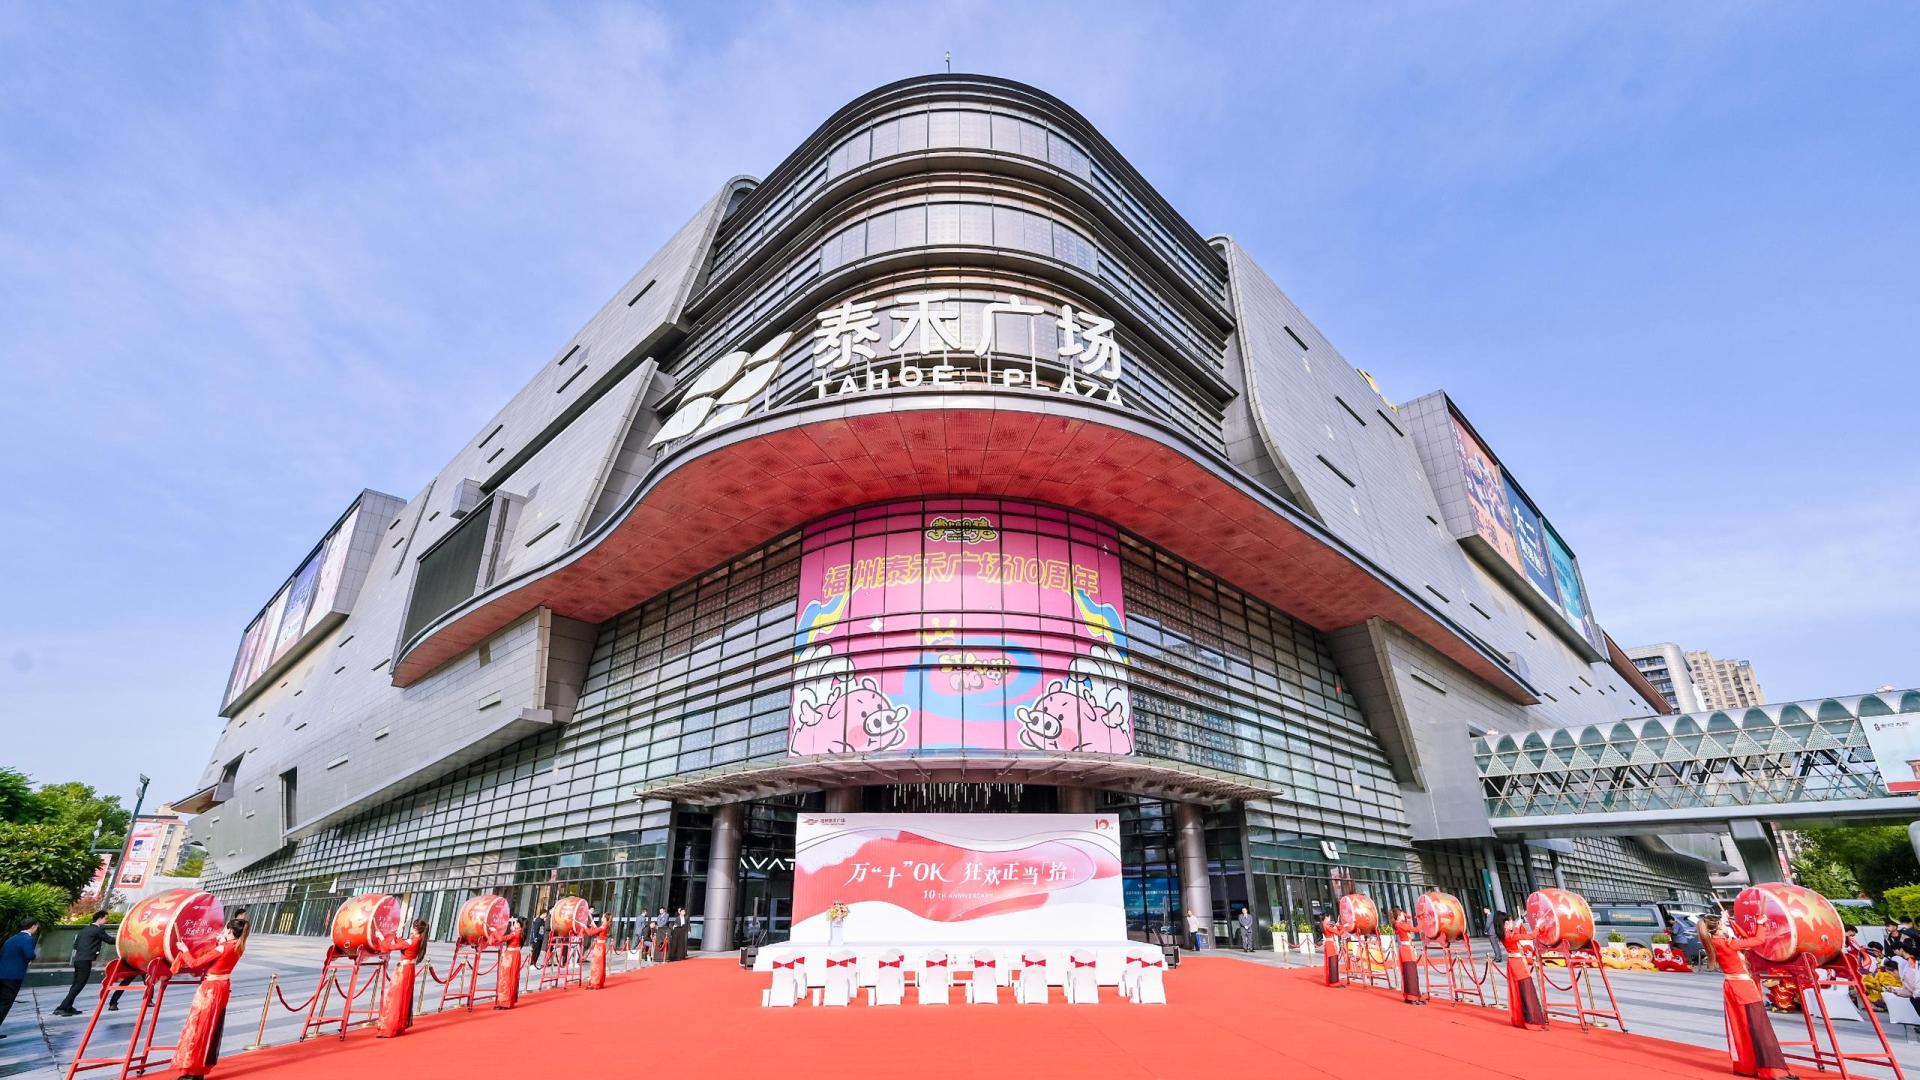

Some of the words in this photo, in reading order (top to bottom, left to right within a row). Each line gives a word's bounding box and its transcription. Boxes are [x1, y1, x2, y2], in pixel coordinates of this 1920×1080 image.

[812, 292, 1123, 381] 泰禾广场
[812, 365, 960, 399] TAHOE
[1003, 367, 1124, 406] PLAZA
[822, 551, 1099, 598] 福州泰禾广场10周年
[923, 889, 936, 899] 10
